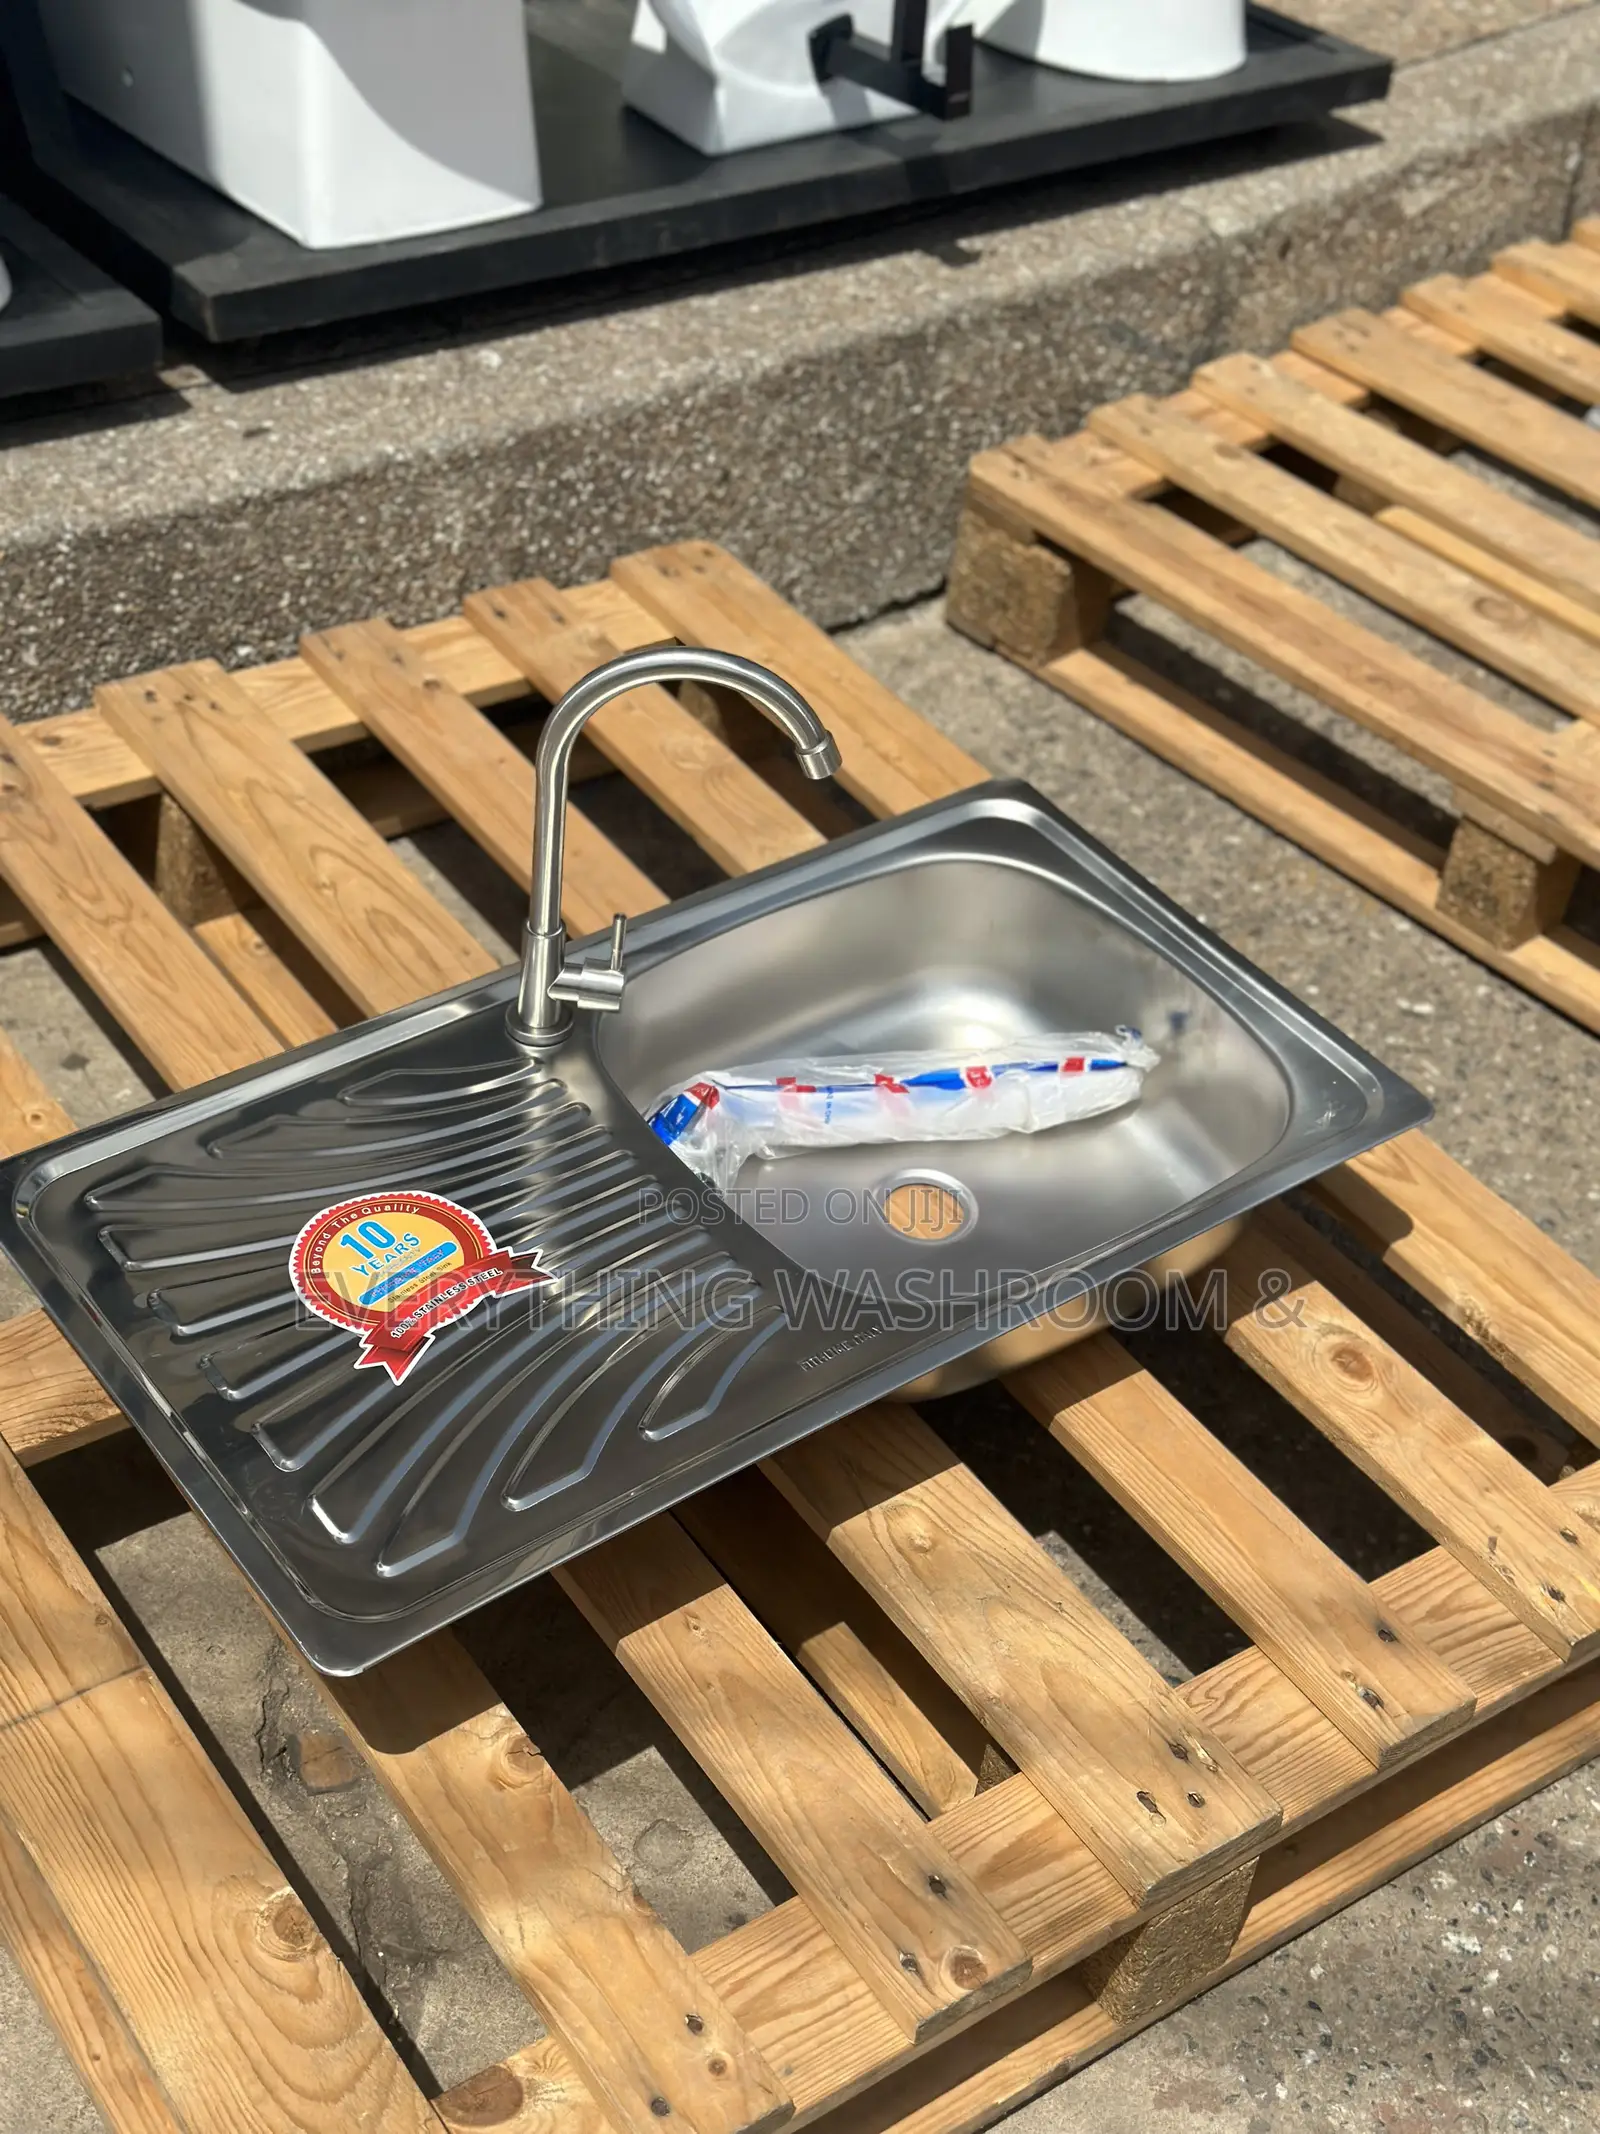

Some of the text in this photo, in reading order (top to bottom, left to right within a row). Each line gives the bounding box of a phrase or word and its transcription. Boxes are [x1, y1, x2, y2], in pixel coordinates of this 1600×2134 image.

[311, 1203, 420, 1274] Beyond The Quality
[341, 1221, 395, 1259] 10
[351, 1234, 420, 1276] YEARS
[388, 1261, 452, 1302] Stainless Steel Sink
[392, 1267, 503, 1337] 100% STAINLESS STEEL
